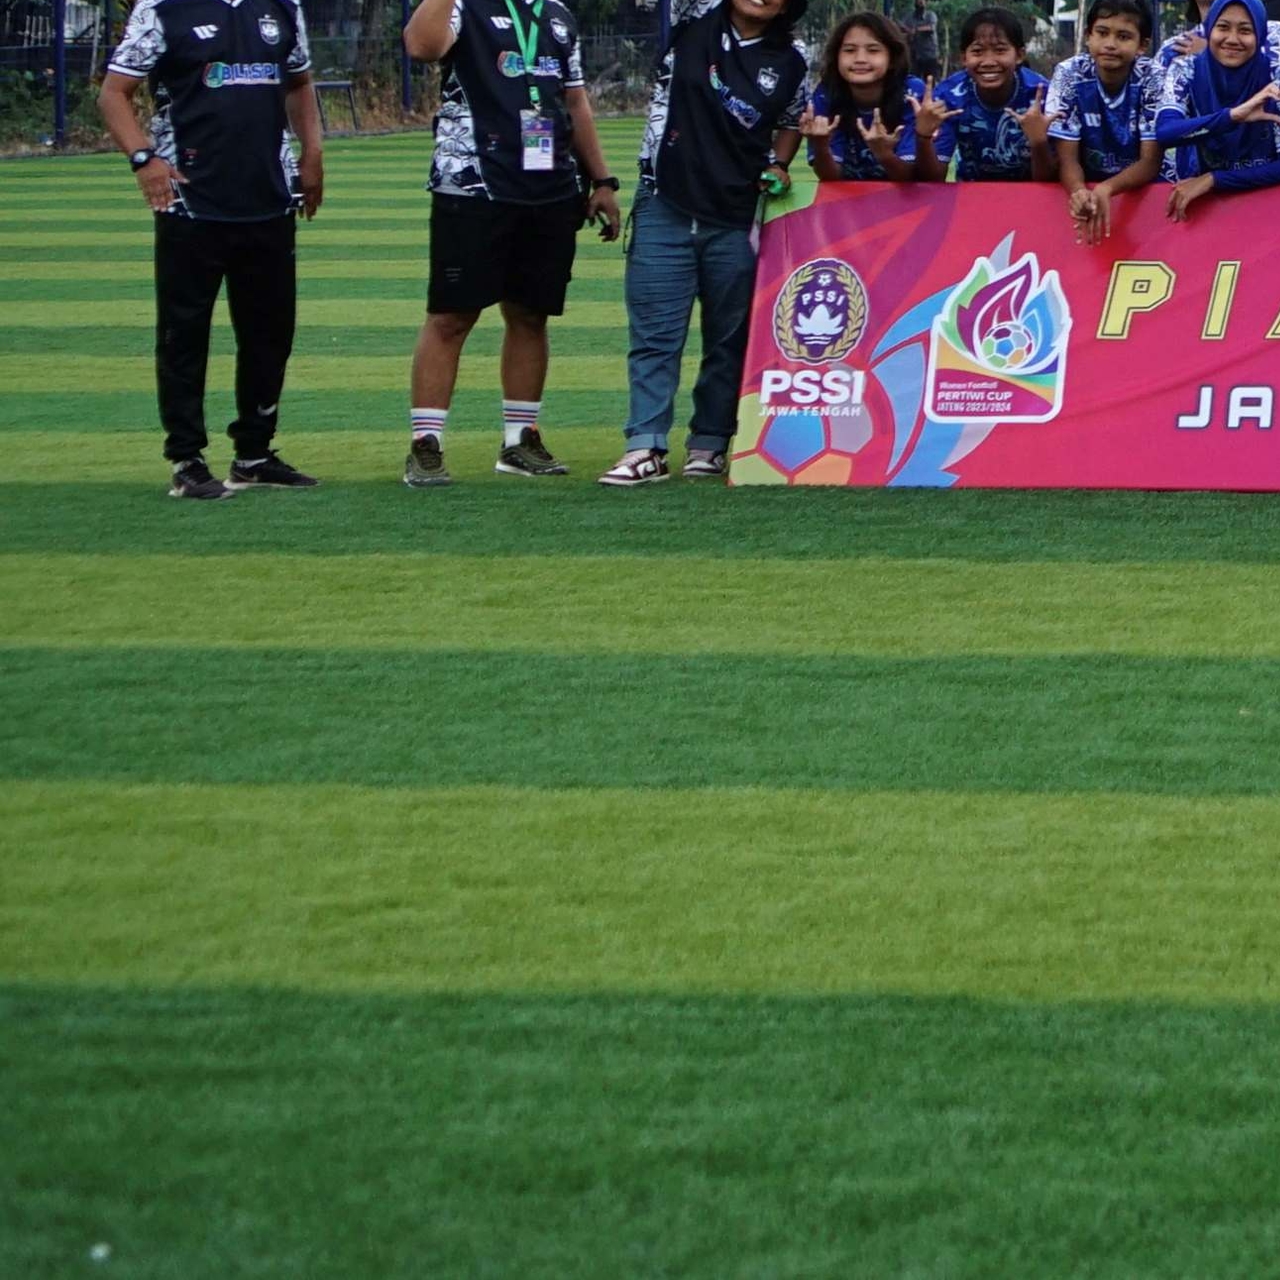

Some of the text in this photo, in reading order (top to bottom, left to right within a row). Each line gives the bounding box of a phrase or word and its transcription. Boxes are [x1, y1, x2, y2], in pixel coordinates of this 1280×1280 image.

[801, 290, 846, 306] PSSI
[759, 370, 865, 404] PSSI
[937, 391, 1014, 401] PERTIWI CUP
[758, 405, 861, 417] JAWA TENGAH
